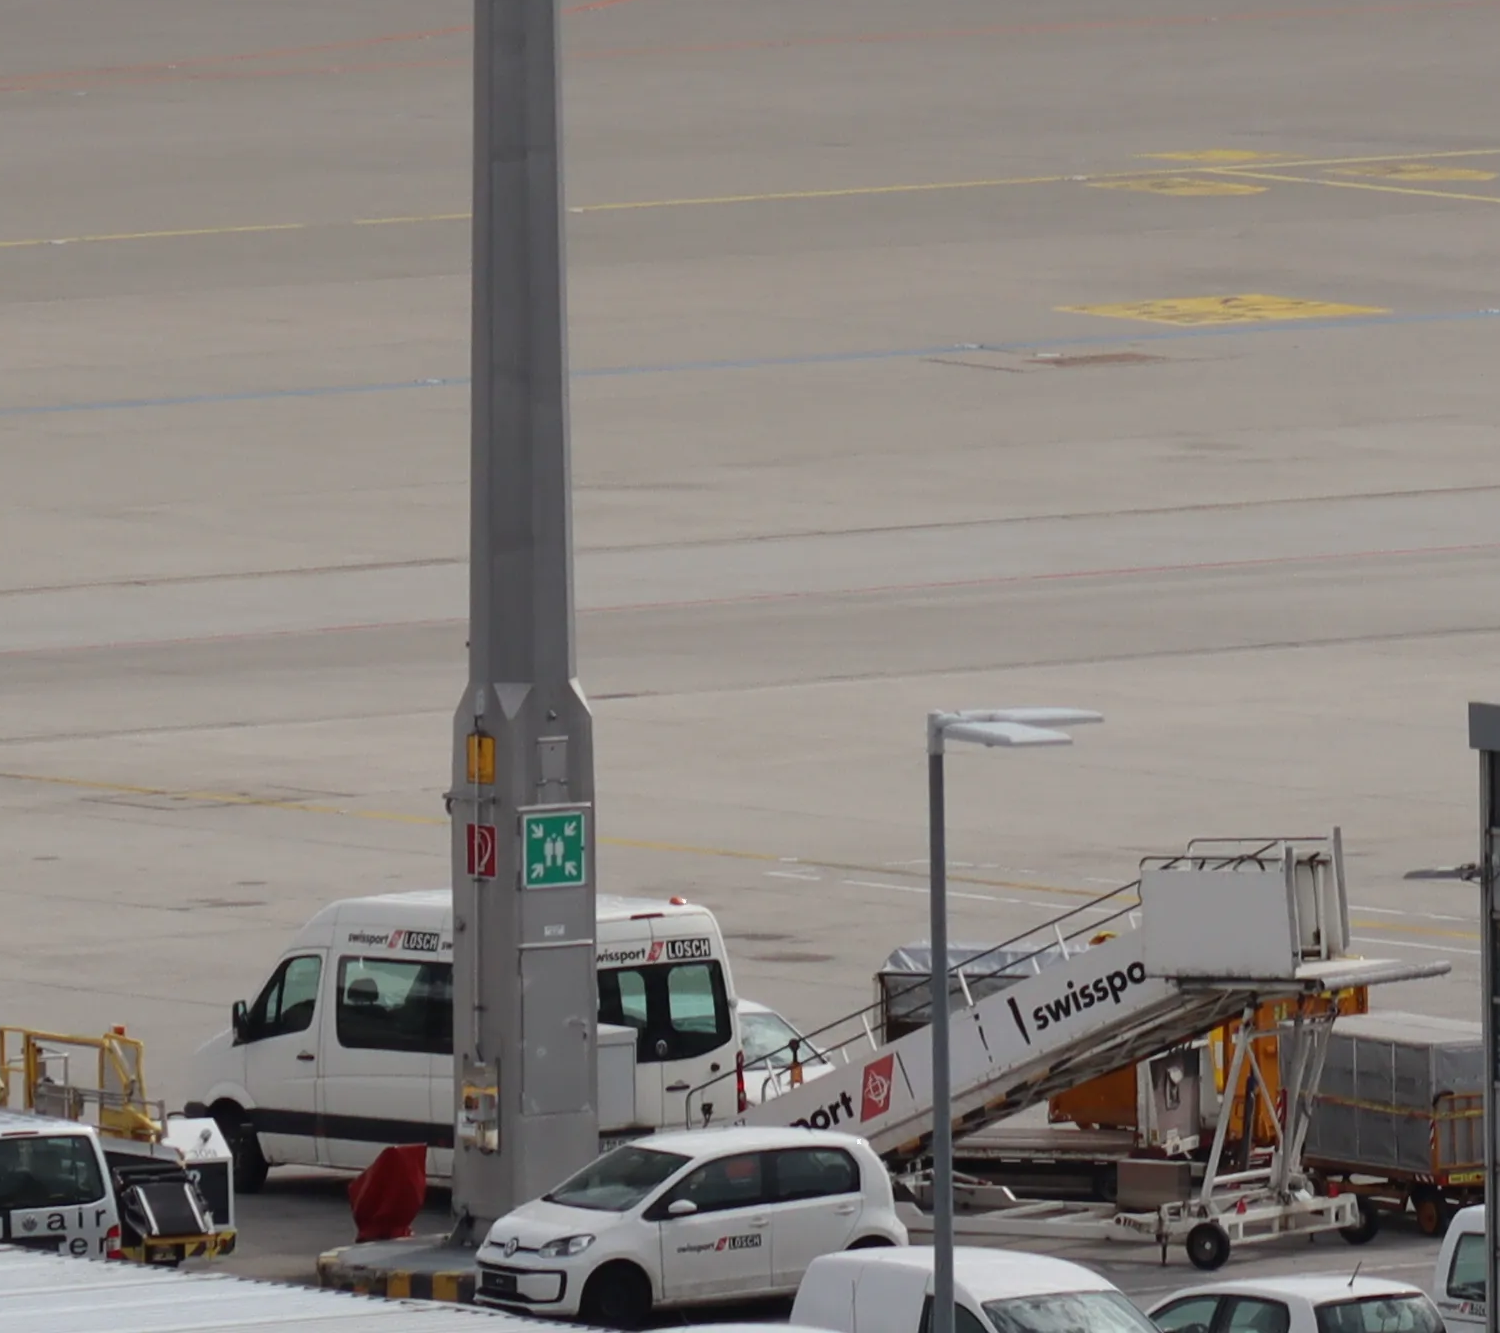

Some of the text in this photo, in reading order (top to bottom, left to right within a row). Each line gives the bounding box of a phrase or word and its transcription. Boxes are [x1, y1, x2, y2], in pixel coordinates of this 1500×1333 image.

[402, 931, 439, 951] LOSCH
[596, 939, 710, 964] wissport LOSCH
[1032, 961, 1147, 1032] swisspo
[46, 1206, 107, 1231] air
[729, 1234, 761, 1250] LOSCH
